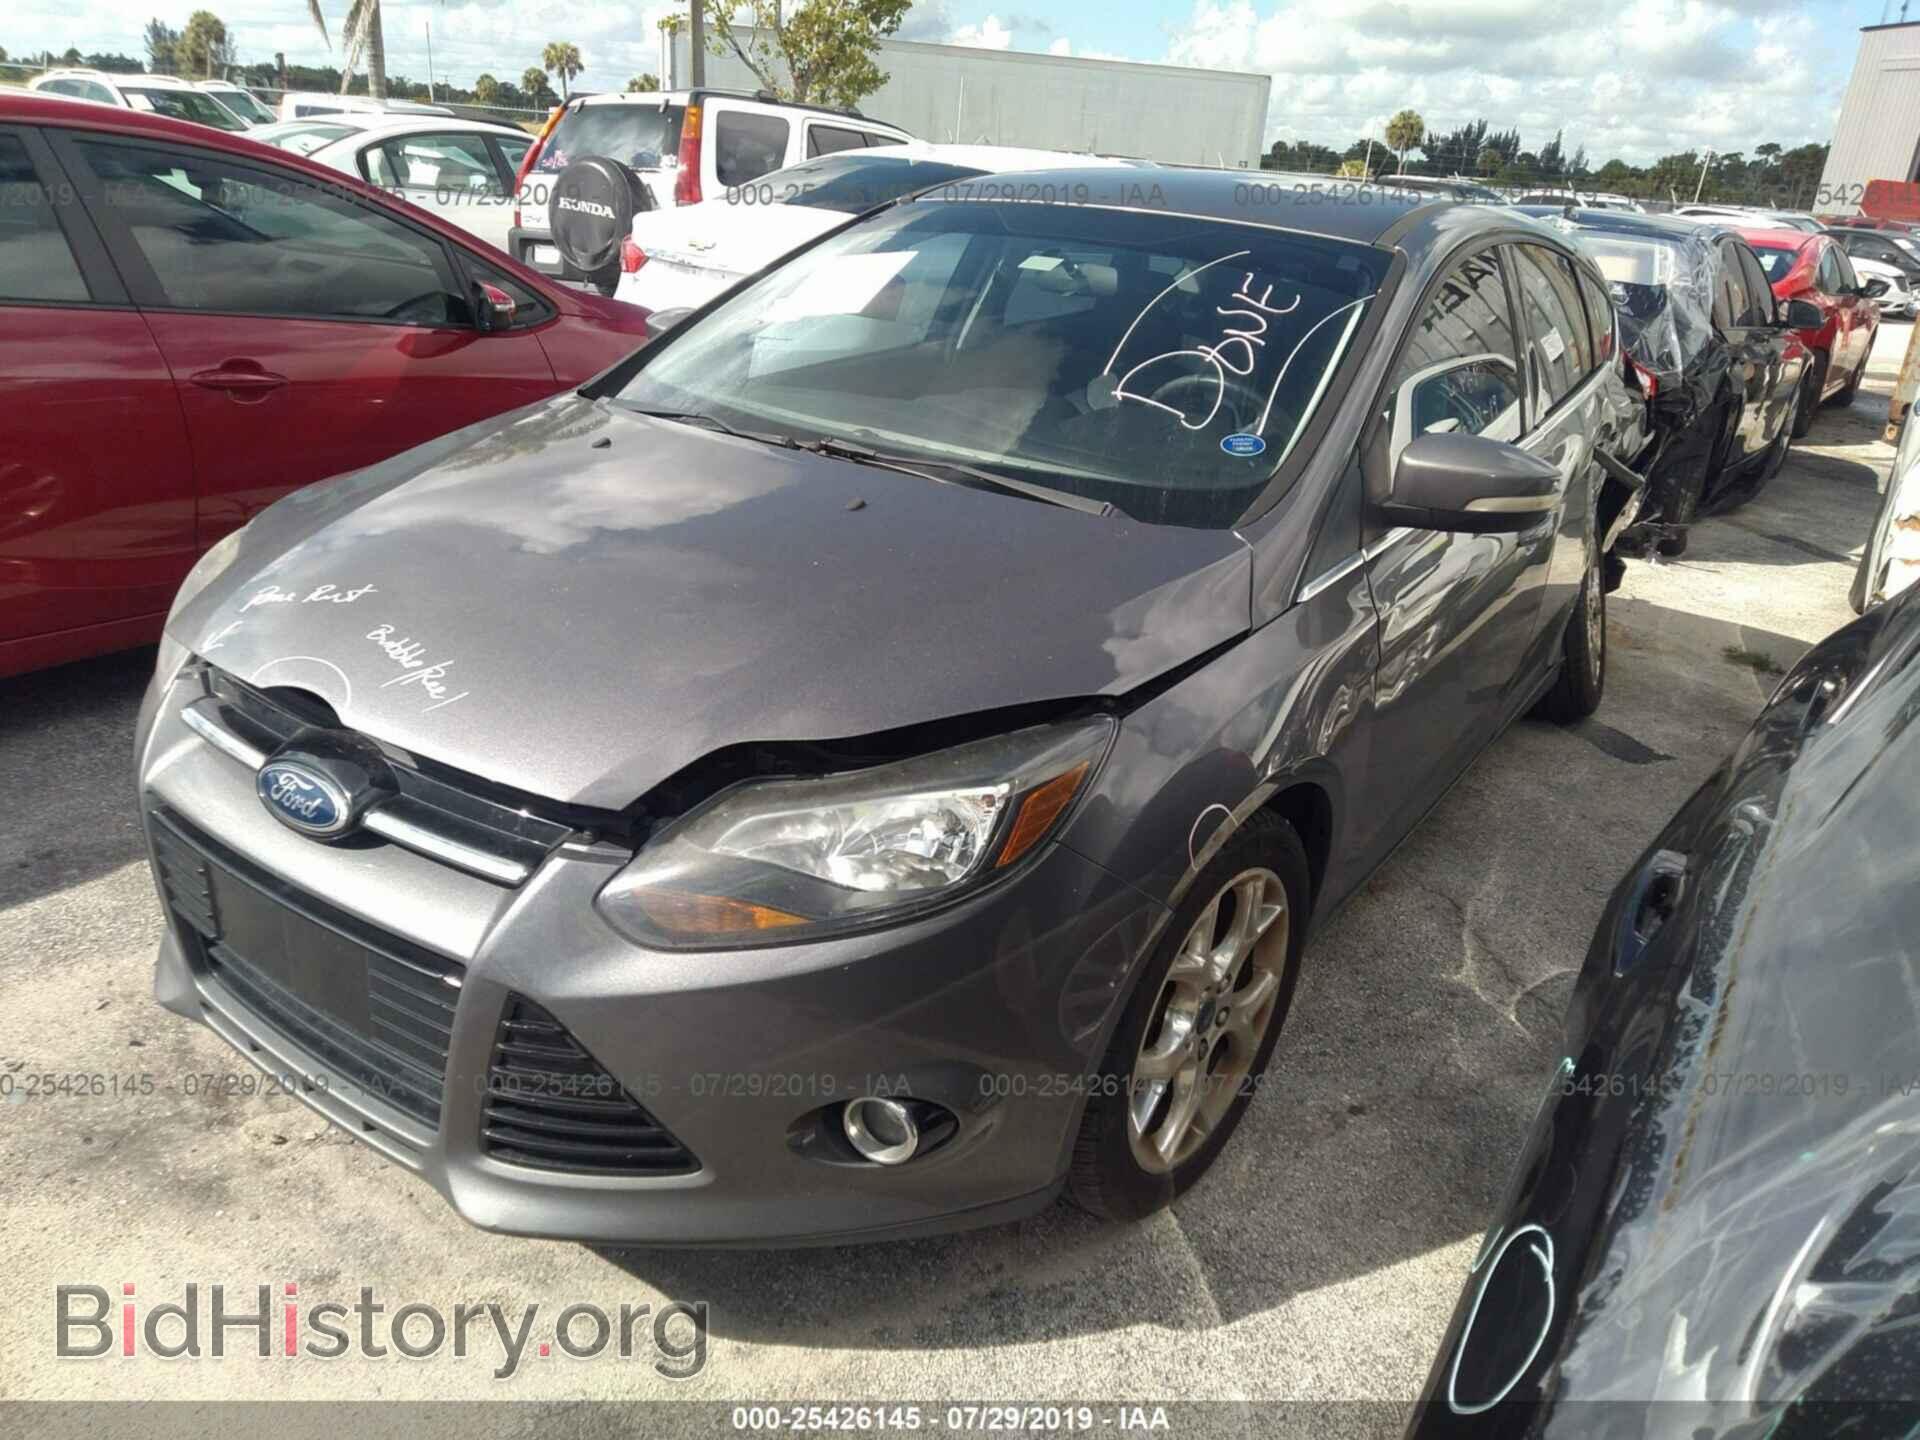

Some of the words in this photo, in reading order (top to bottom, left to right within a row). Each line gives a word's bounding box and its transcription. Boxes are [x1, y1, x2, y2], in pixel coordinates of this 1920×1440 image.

[558, 197, 616, 219] HONDA
[1111, 272, 1301, 430] DONE
[271, 773, 323, 818] Ford
